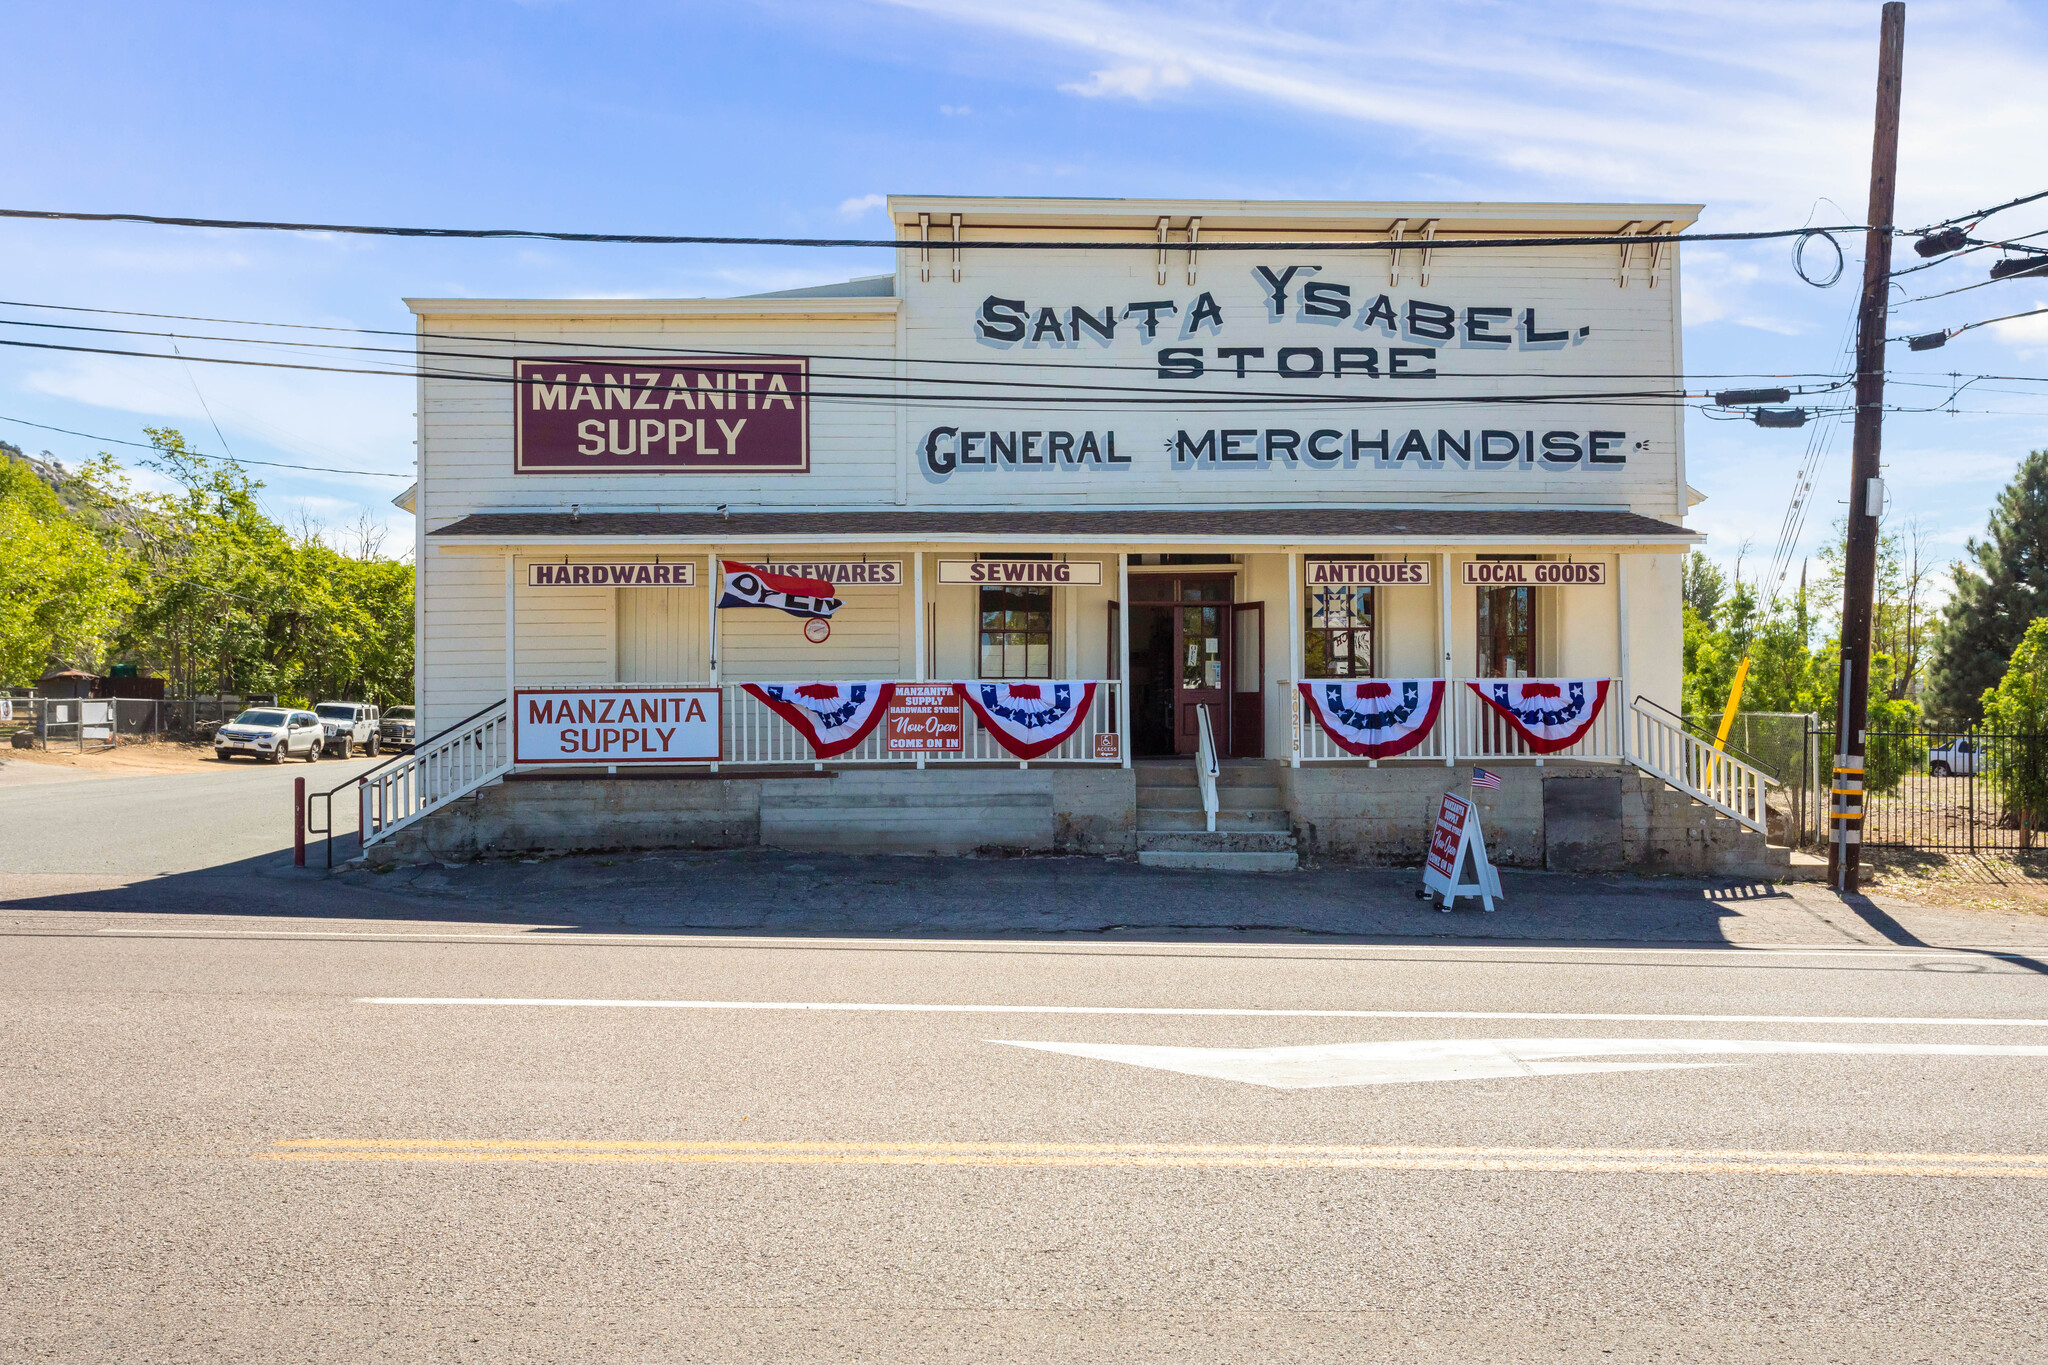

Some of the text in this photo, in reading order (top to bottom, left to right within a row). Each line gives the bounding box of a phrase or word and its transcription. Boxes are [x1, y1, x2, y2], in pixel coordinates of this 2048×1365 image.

[976, 291, 1224, 342] SANTA
[1157, 347, 1437, 380] STORE
[532, 373, 795, 410] MANZANITA
[578, 418, 747, 455] SUPPLY
[925, 426, 1627, 474] GENERAL MERCHANDISE
[536, 565, 687, 584] HARDWARE
[970, 563, 1070, 582] SEWING
[1314, 564, 1423, 584] ANTIQUES
[1467, 564, 1601, 583] LOCAL GOODS
[895, 687, 954, 696] MANZANITA
[905, 697, 943, 706] SUPPLY
[529, 698, 707, 725] MANZANITA
[890, 706, 959, 714] HARDWARE STORE
[1292, 688, 1300, 751] 30275
[891, 716, 958, 737] Now Open
[561, 728, 677, 753] SUPPLY
[890, 739, 959, 748] COME ON IN
